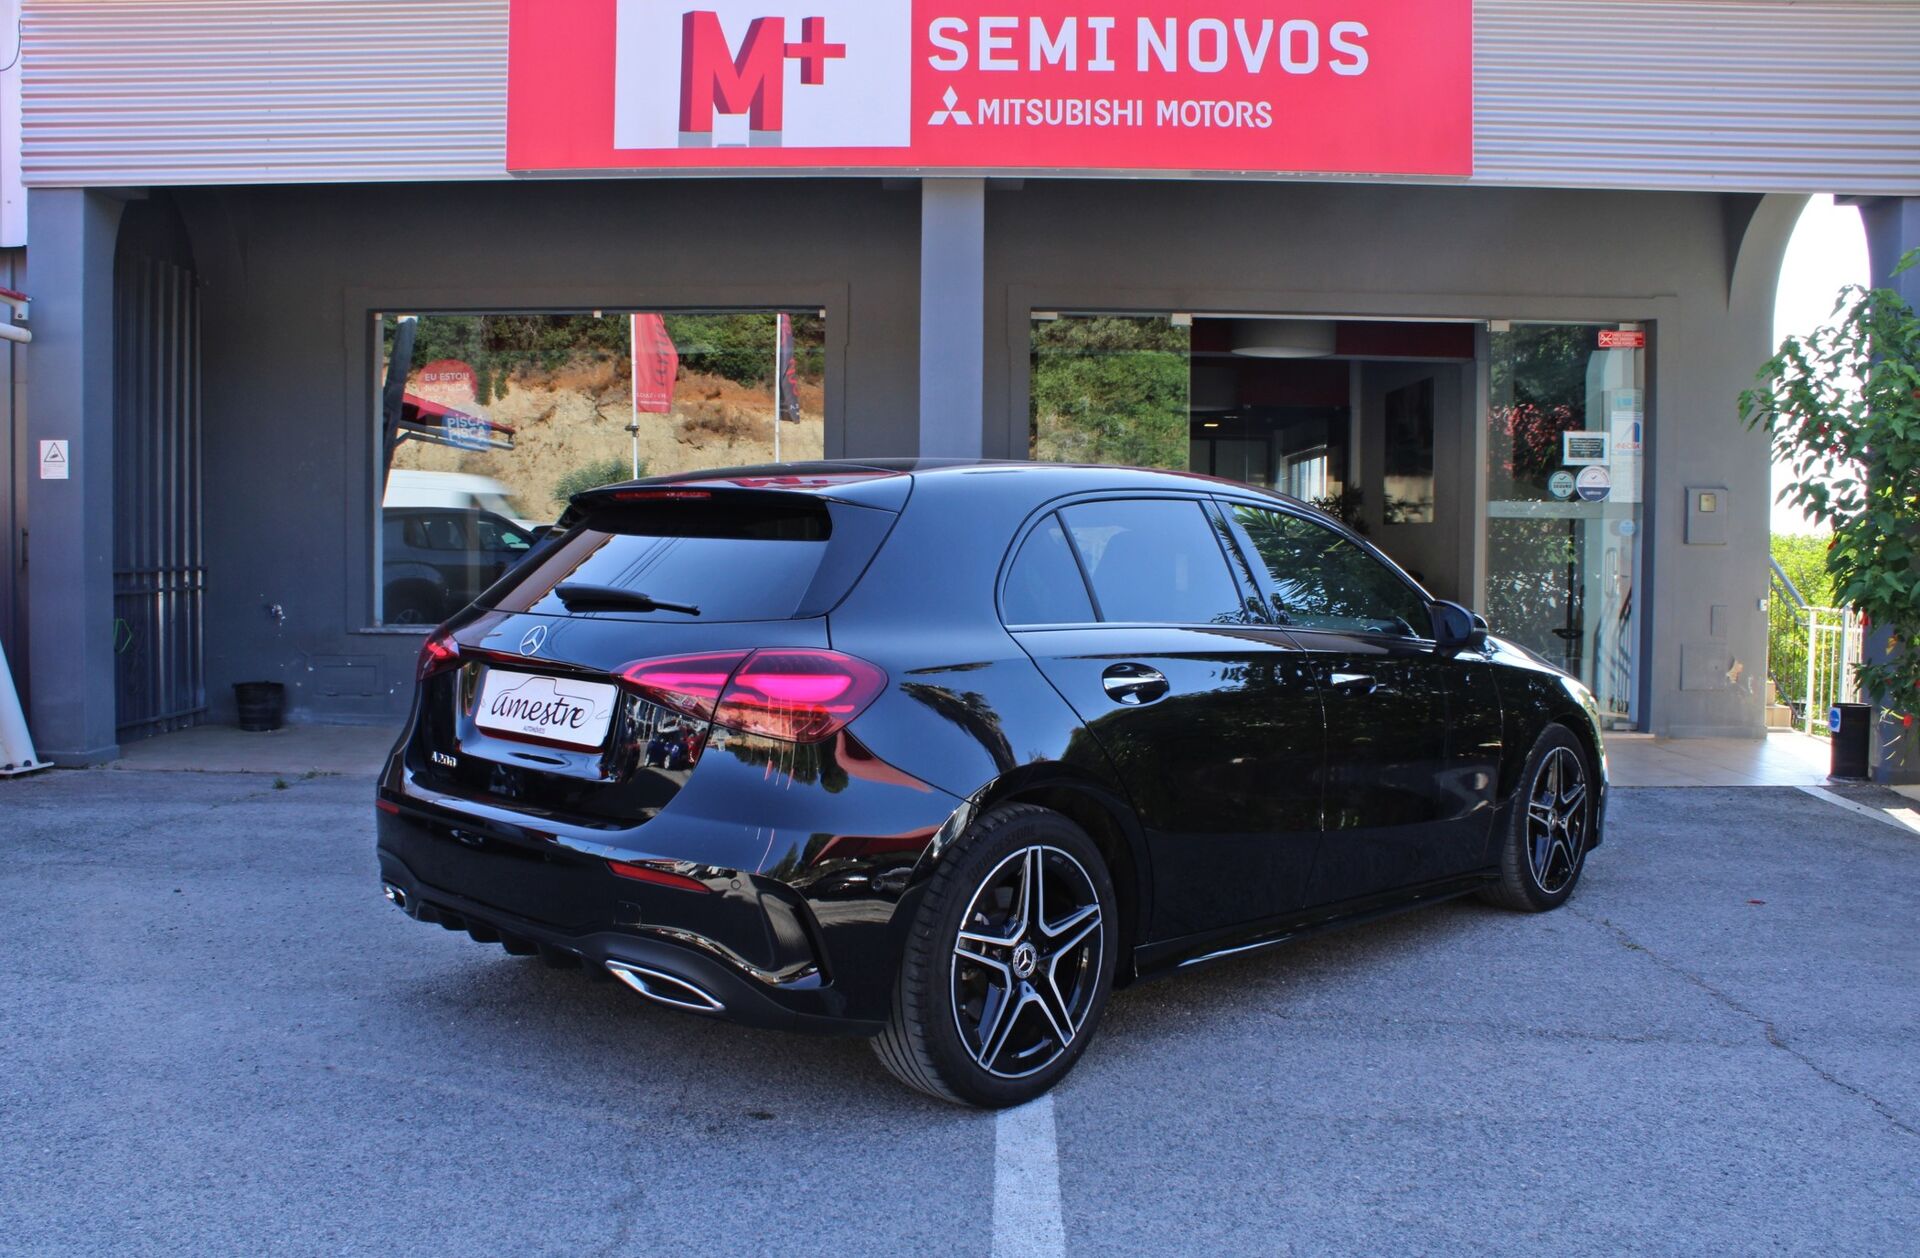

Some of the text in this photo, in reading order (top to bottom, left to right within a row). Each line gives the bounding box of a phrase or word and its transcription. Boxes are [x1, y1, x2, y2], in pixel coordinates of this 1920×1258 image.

[929, 16, 1369, 76] SEMI NOVOS
[978, 98, 1273, 128] MITSUBISHI MOTORS
[424, 372, 470, 382] EU ESTOU
[491, 695, 585, 729] amestre
